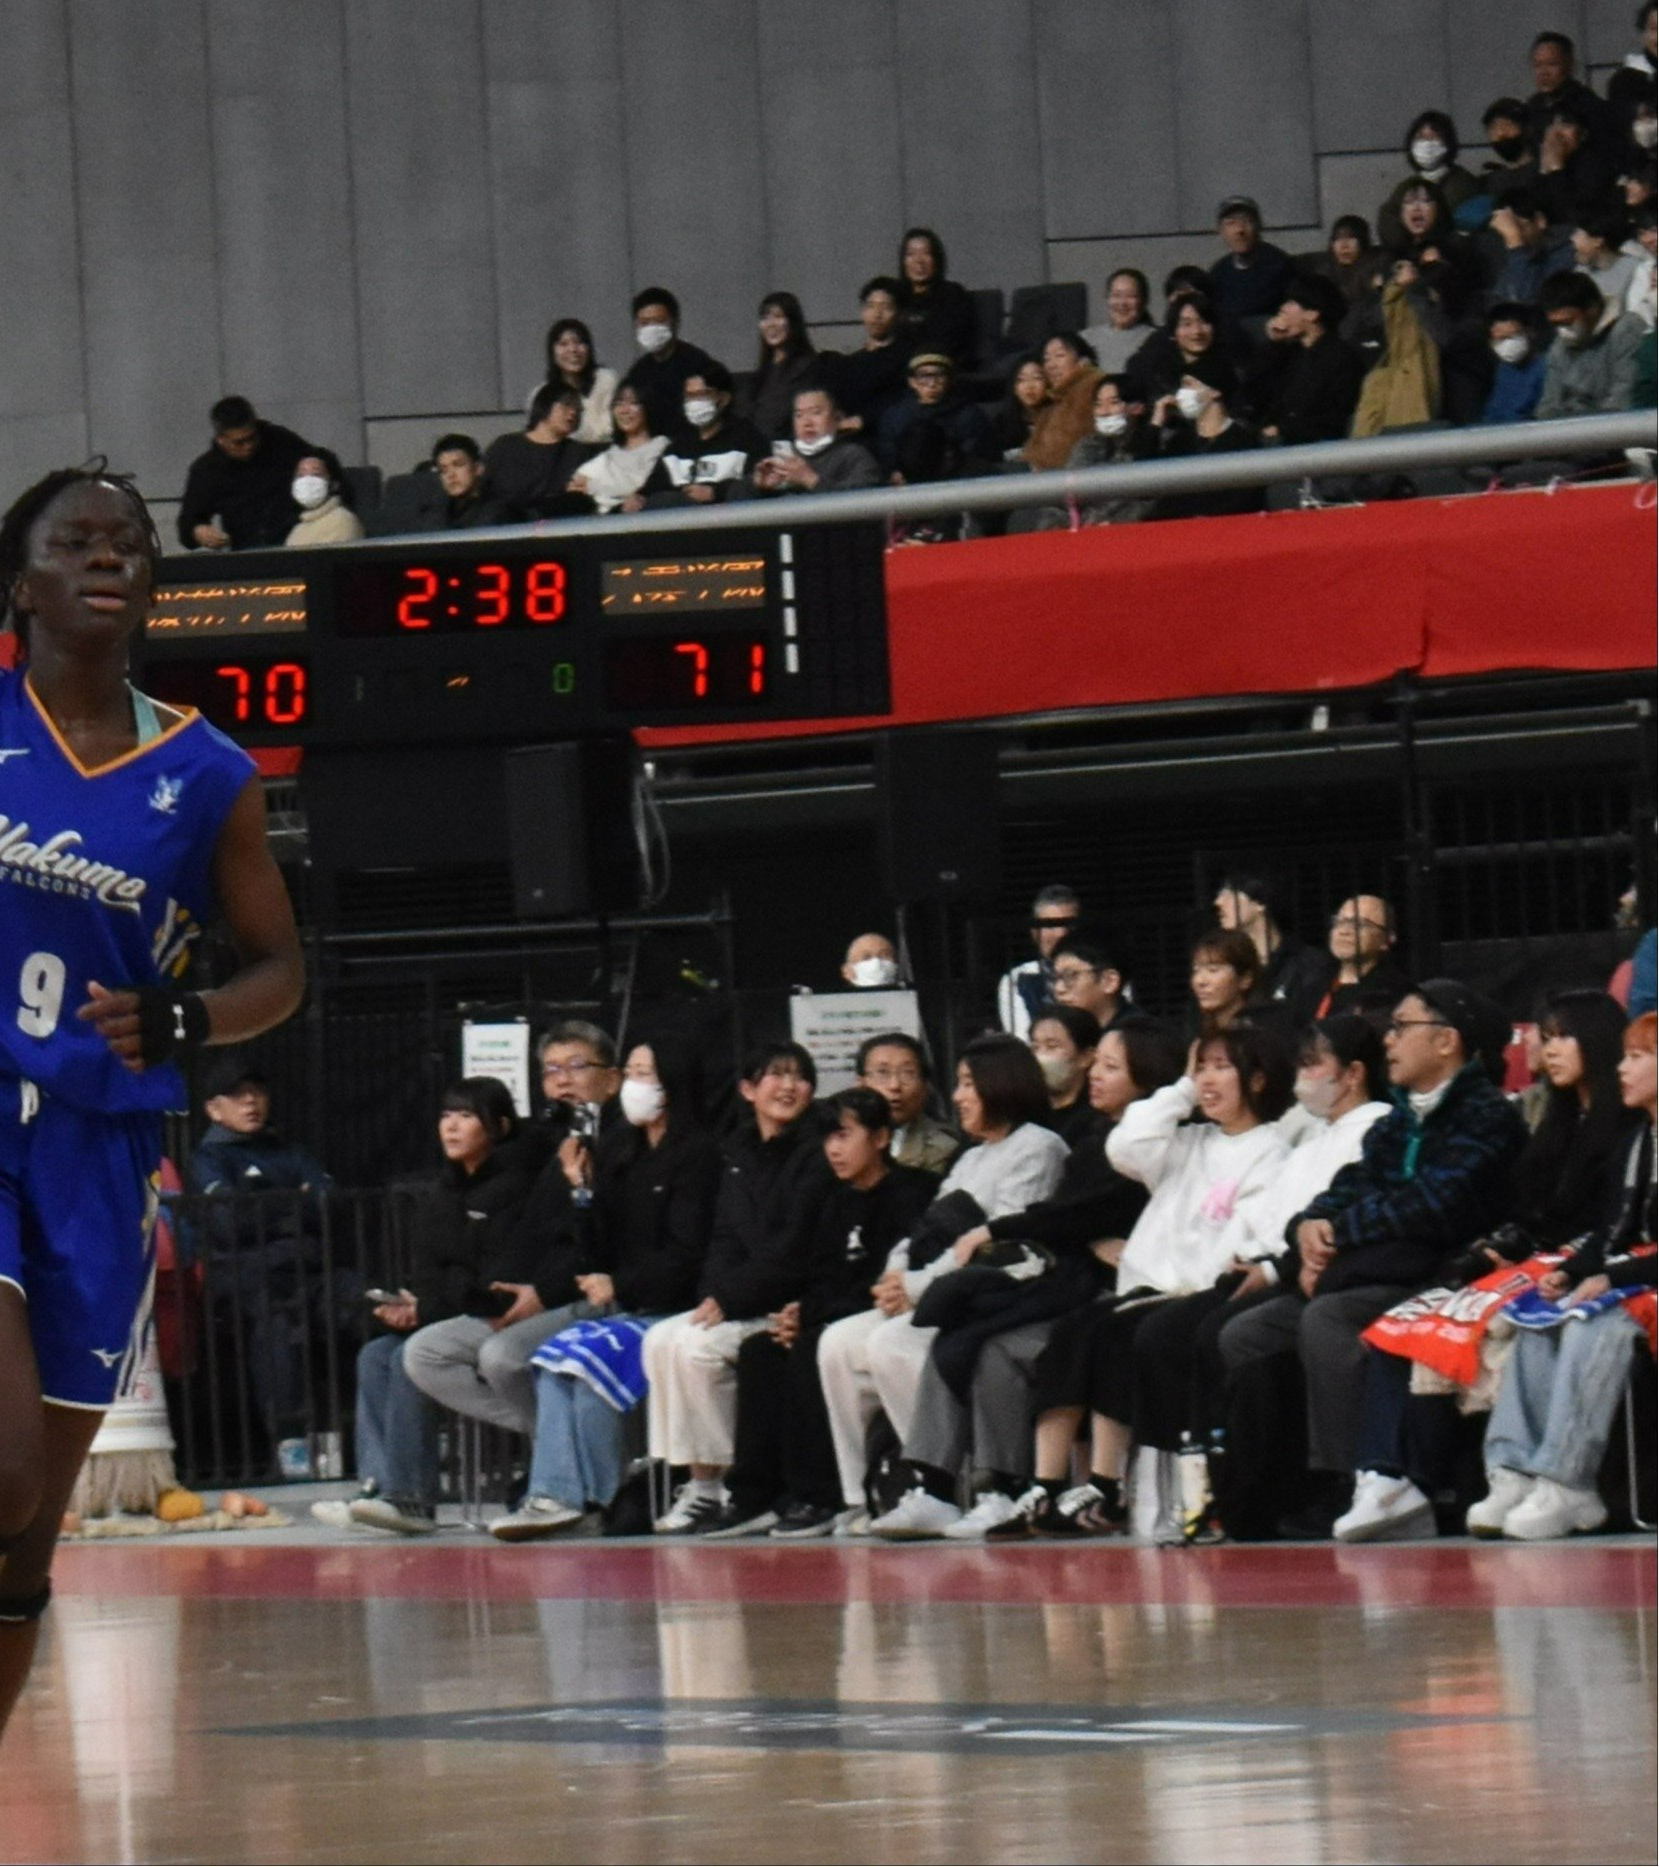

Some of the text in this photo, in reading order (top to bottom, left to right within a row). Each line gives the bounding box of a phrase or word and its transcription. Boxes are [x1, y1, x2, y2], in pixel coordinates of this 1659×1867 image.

[398, 562, 566, 630] 2:38
[215, 663, 307, 725] 70
[674, 642, 766, 696] 71
[17, 951, 66, 1039] 9
